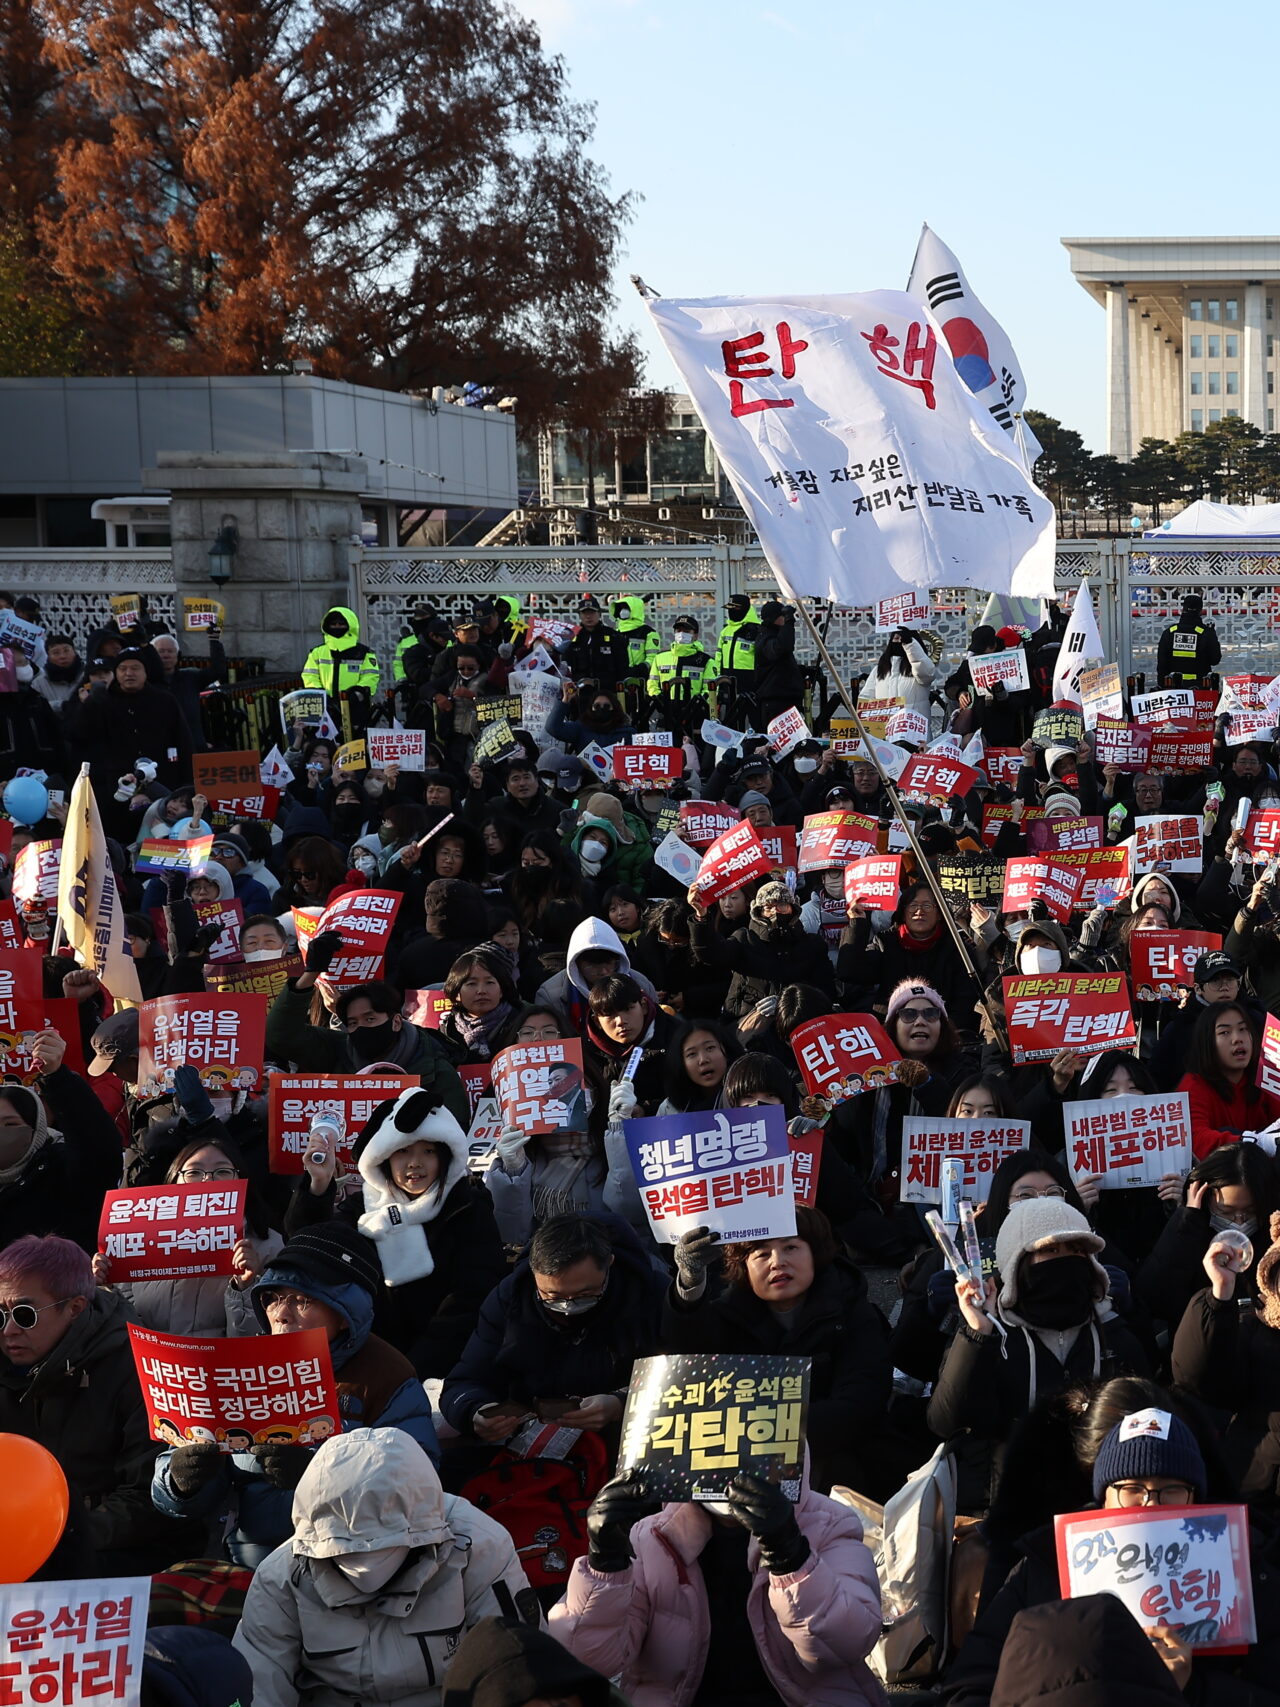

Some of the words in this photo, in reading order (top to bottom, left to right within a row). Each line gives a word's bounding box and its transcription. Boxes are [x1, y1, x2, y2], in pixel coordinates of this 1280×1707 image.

[852, 484, 917, 516] 지리산
[925, 481, 985, 514] 반달곰
[987, 492, 1034, 523] 가족
[879, 592, 915, 614] 윤석열
[902, 605, 928, 624] 탄핵!
[975, 666, 1020, 689] 체포하라
[1138, 694, 1188, 713] 내란수괴
[1096, 728, 1133, 745] 국지전
[1180, 742, 1211, 755] 국민의힘
[371, 743, 424, 763] 체포하라
[624, 755, 669, 776] 탄핵
[1096, 746, 1148, 764] 도발중단!
[911, 763, 961, 793] 탄핵
[806, 814, 844, 829] 내란수괴
[843, 814, 875, 831] 윤석열
[1052, 817, 1088, 833] 반란수괴
[722, 826, 753, 854] 퇴진!
[804, 827, 838, 848] 즉각
[1057, 826, 1099, 847] 윤석열
[868, 862, 896, 876] 퇴진!
[1089, 850, 1126, 863] 윤석열
[1009, 864, 1049, 879] 윤석열
[1050, 868, 1078, 890] 퇴진!
[1081, 876, 1128, 900] 탄핵!
[355, 896, 394, 914] 퇴진!
[325, 956, 382, 981] 탄핵!
[1007, 981, 1069, 998] 내란수괴
[1071, 976, 1122, 995] 윤석열
[152, 1010, 241, 1038] 윤석열을
[1010, 999, 1070, 1028] 즉각
[1063, 1010, 1129, 1043] 탄핵!
[152, 1038, 240, 1069] 탄핵하라
[510, 1044, 565, 1068] 반헌법
[800, 1023, 884, 1084] 탄핵
[515, 1101, 570, 1130] 구속
[1071, 1108, 1128, 1136] 내란범
[1130, 1100, 1184, 1128] 윤석열
[909, 1130, 965, 1152] 내란범
[968, 1127, 1025, 1149] 윤석열
[1072, 1122, 1188, 1175] 체포하라
[646, 1180, 709, 1221] 윤석열
[712, 1163, 785, 1208] 탄핵!
[107, 1196, 180, 1226] 윤석열
[183, 1190, 239, 1218] 퇴진!
[132, 1329, 159, 1344] 나눔문화
[159, 1339, 215, 1353] www.nanum.com
[141, 1356, 209, 1391] 내란당
[212, 1356, 323, 1393] 국민의힘
[733, 1375, 802, 1403] 윤석열
[147, 1385, 216, 1420] 법대로
[222, 1385, 329, 1424] 정당해산
[1115, 1541, 1191, 1585] 윤석열
[1140, 1568, 1222, 1630] 탄핵
[7, 1596, 133, 1653] 윤석열
